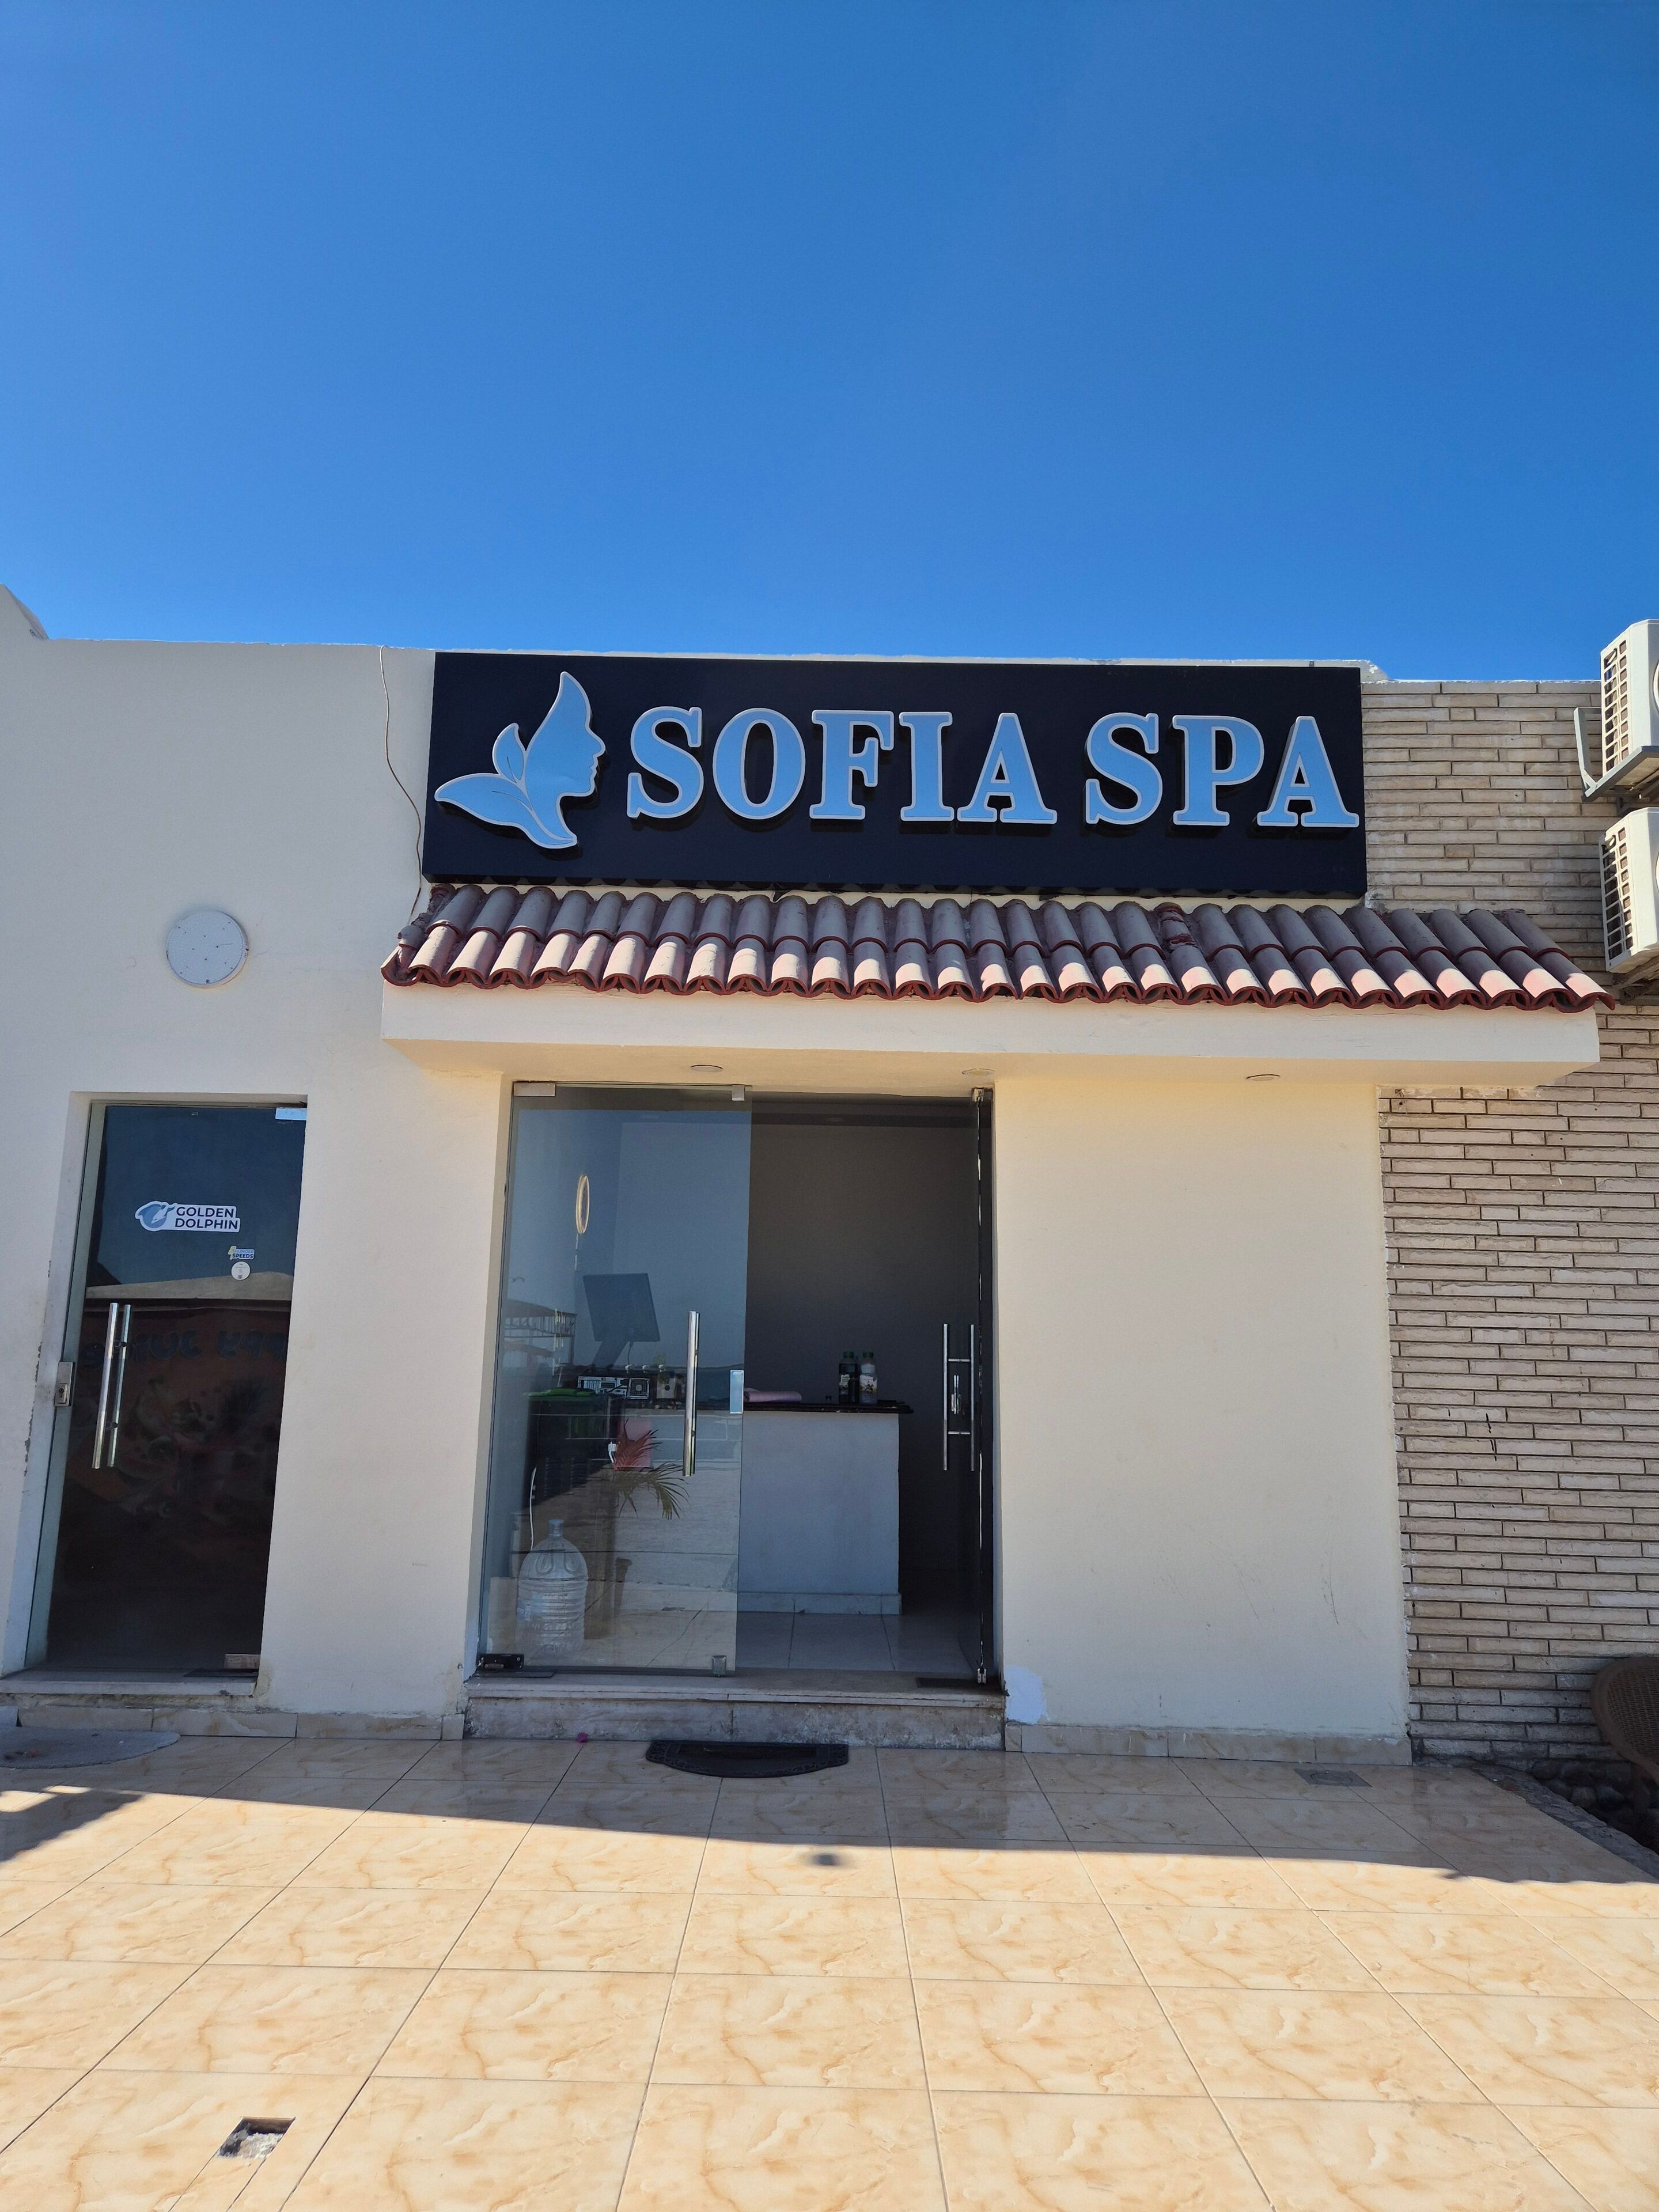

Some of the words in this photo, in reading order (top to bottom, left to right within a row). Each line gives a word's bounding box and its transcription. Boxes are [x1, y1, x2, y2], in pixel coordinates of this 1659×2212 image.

[626, 706, 1058, 825] SOFIA
[1084, 713, 1360, 828] SPA
[176, 1207, 234, 1218] GOLDEN
[175, 1218, 238, 1229] DOLPHIN
